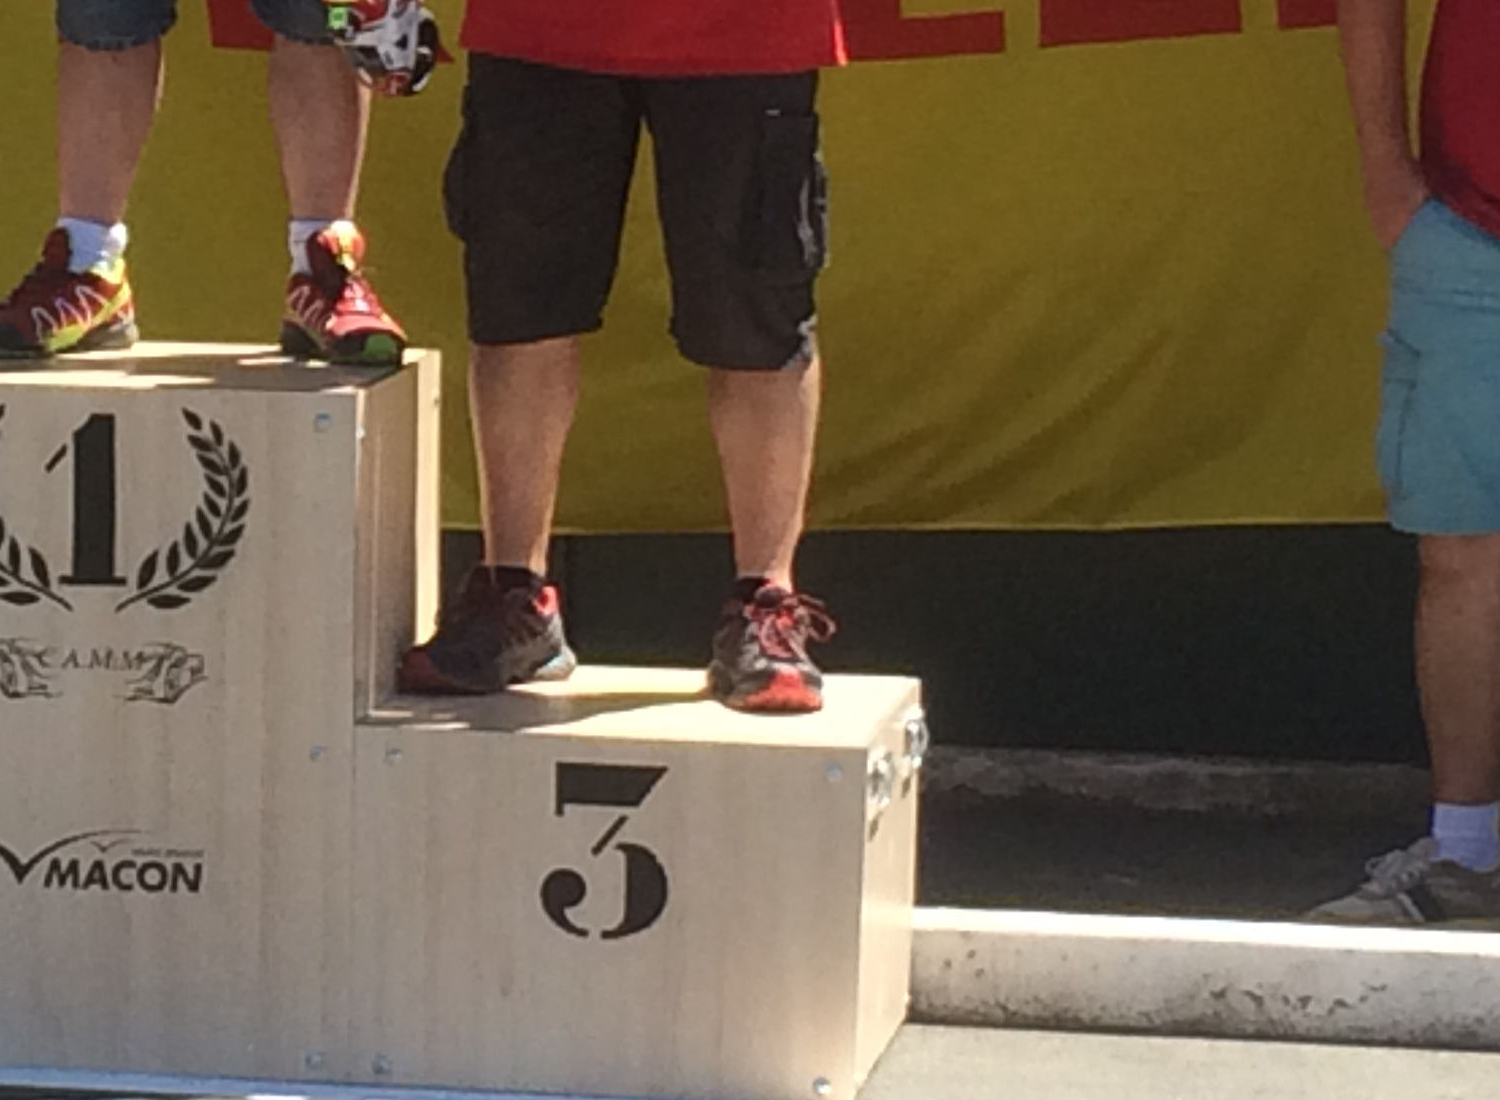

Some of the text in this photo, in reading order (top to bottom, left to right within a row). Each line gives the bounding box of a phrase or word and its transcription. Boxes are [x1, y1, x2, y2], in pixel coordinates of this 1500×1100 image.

[45, 413, 127, 587] 1
[43, 857, 203, 893] MACON
[540, 761, 669, 939] 3
